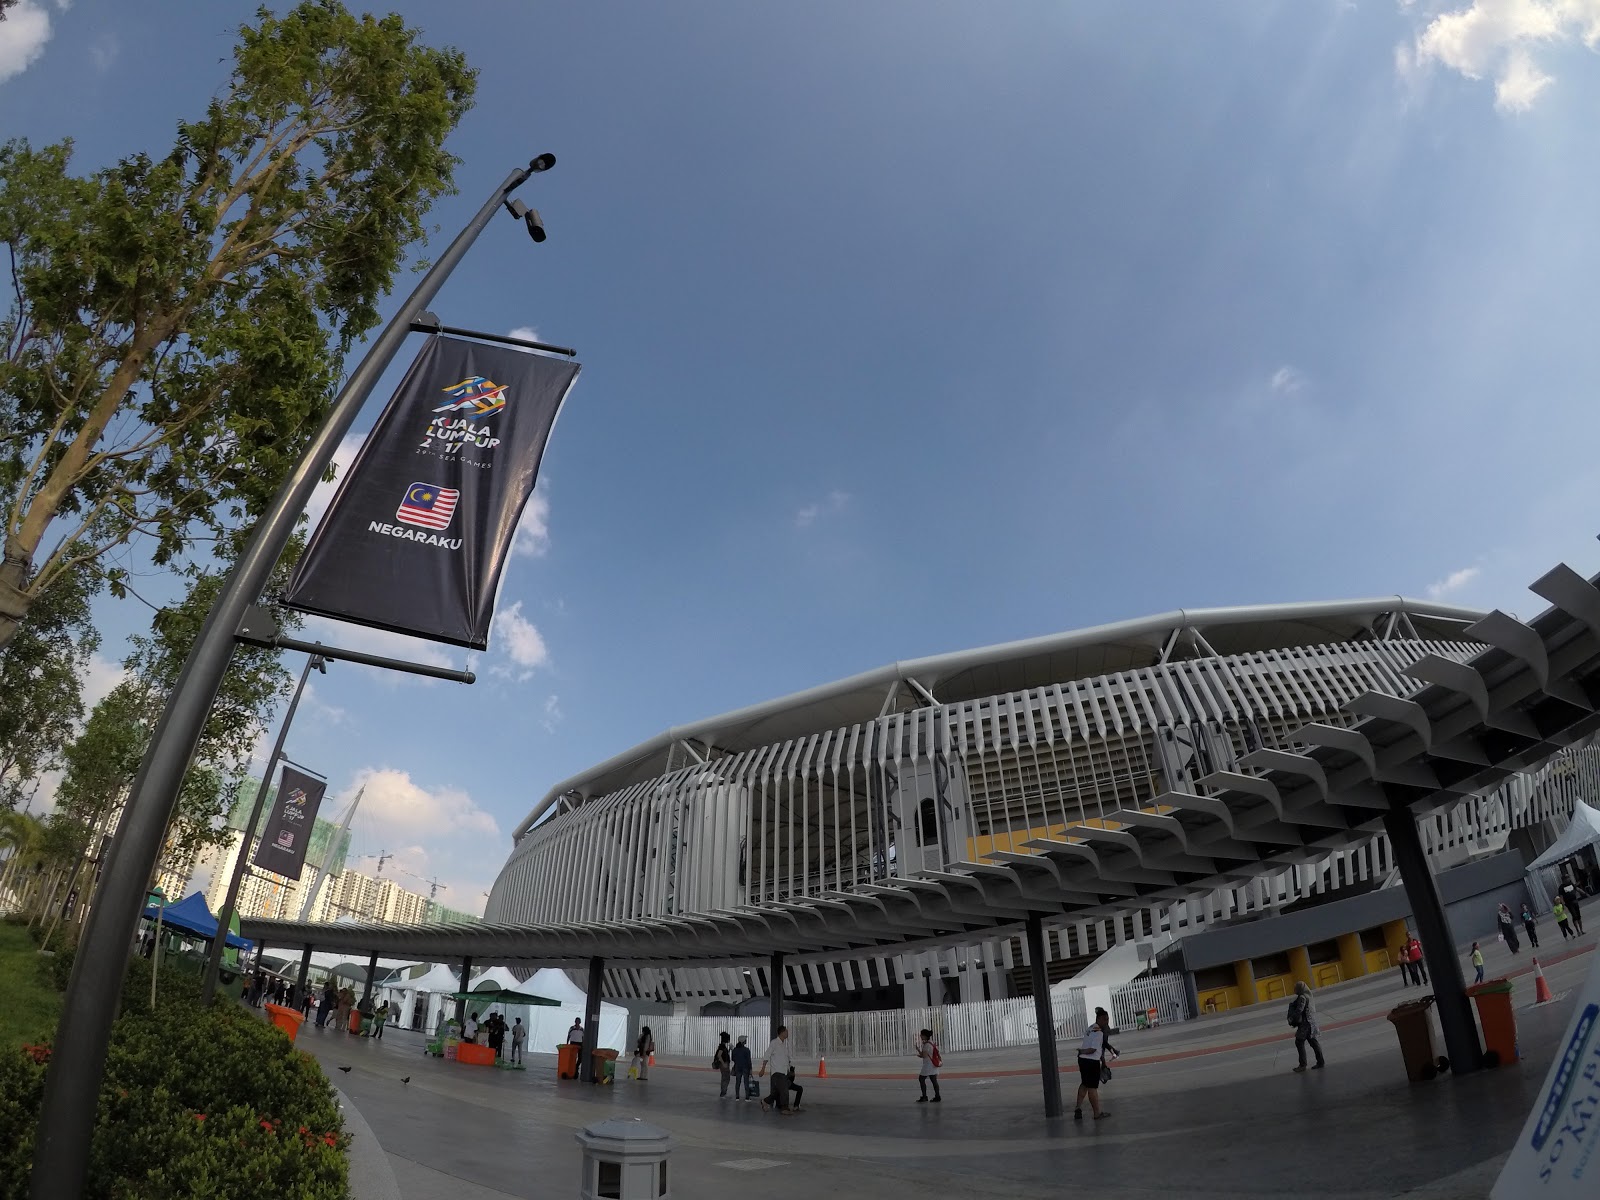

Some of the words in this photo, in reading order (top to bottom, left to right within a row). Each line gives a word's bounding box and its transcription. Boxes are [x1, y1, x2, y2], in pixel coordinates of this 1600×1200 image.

[425, 425, 501, 449] LUMPUR
[431, 415, 491, 437] KUALA
[419, 436, 464, 453] 217
[438, 454, 456, 462] SEA
[460, 456, 492, 469] GAMES
[368, 520, 463, 550] NEGARAKU
[1540, 1098, 1584, 1185] SOYA
